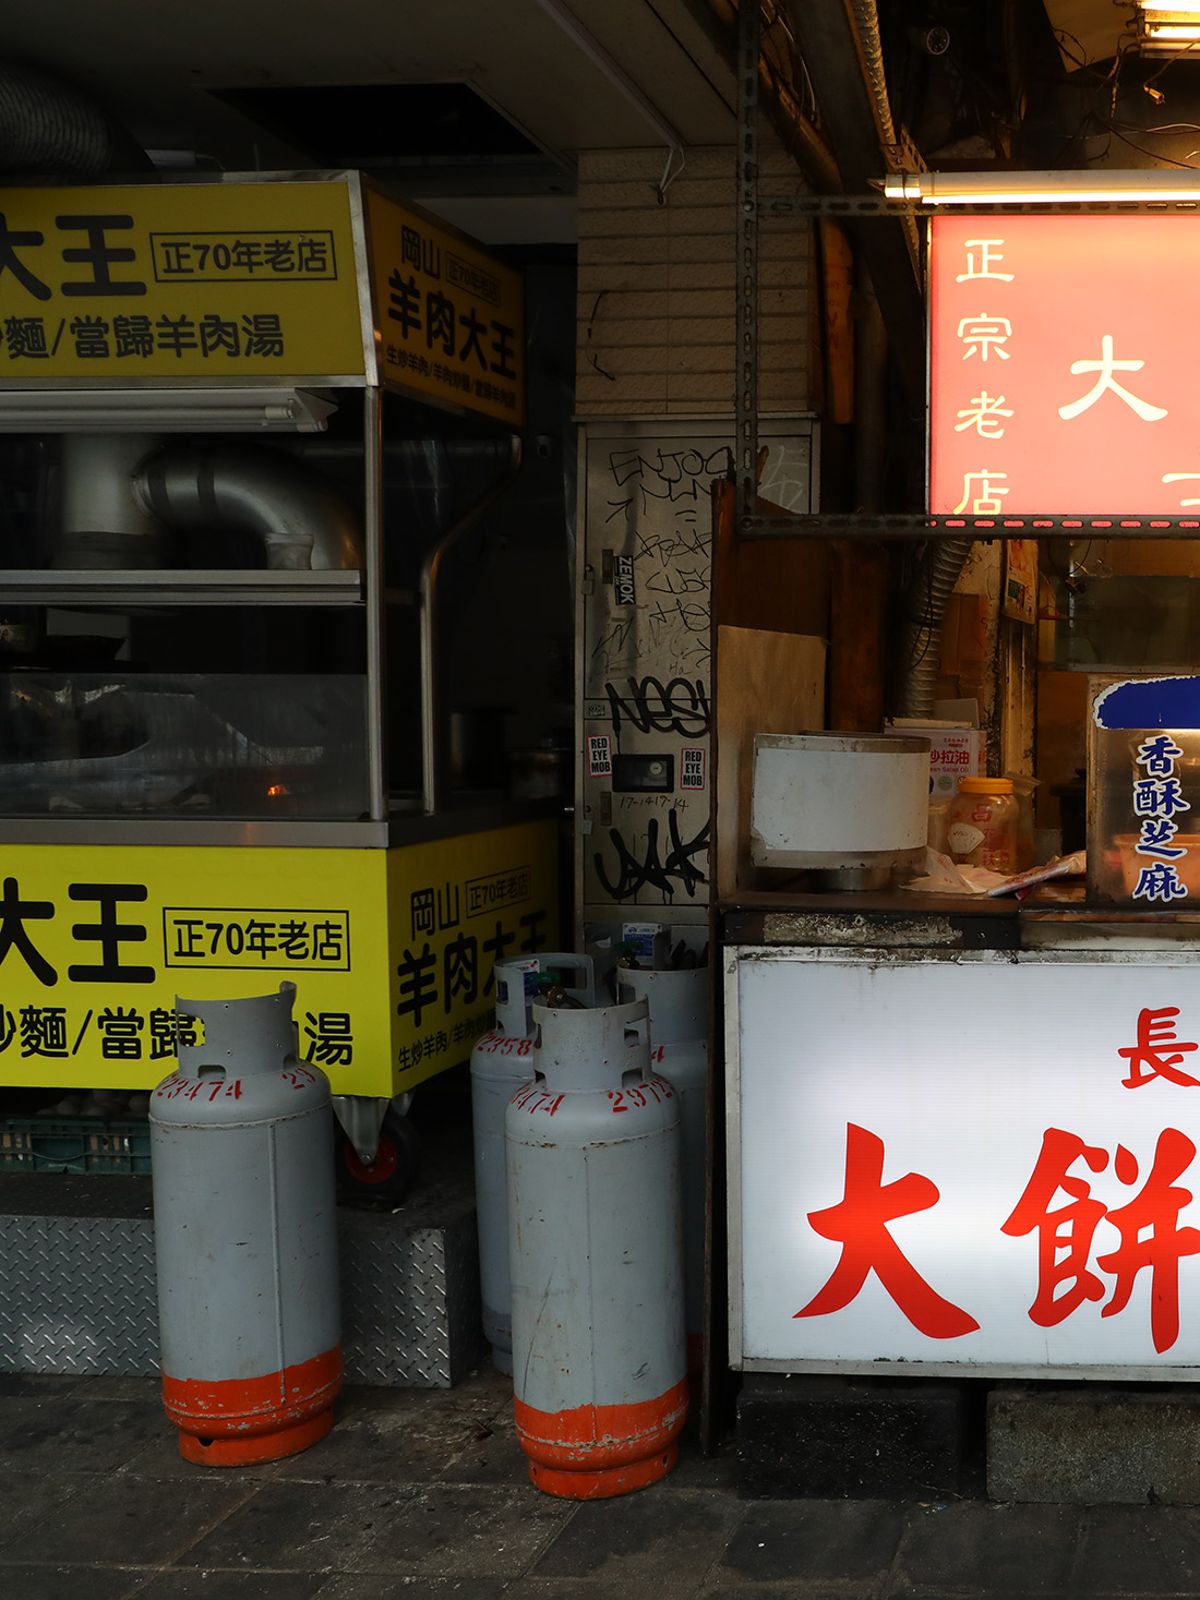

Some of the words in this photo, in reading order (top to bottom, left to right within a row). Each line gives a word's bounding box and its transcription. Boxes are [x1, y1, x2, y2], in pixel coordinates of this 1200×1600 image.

[160, 240, 328, 274] 正70年老店
[401, 225, 440, 280] 岡山
[0, 313, 285, 360] 麵/當歸羊肉湯
[388, 268, 517, 380] 羊肉大王
[954, 239, 1015, 515] 正宗老店
[618, 556, 634, 604] ZEMOK
[591, 738, 608, 750] RED
[593, 750, 608, 761] EYE
[685, 750, 702, 762] RED
[592, 761, 611, 774] MOB
[683, 773, 703, 787] MOB
[686, 762, 701, 774] EYE
[1135, 736, 1187, 899] 香酥芝麻
[411, 882, 459, 941] 岡山
[470, 872, 529, 912] 正70年老店
[0, 877, 155, 987] 大王
[173, 918, 343, 961] 正70年老店
